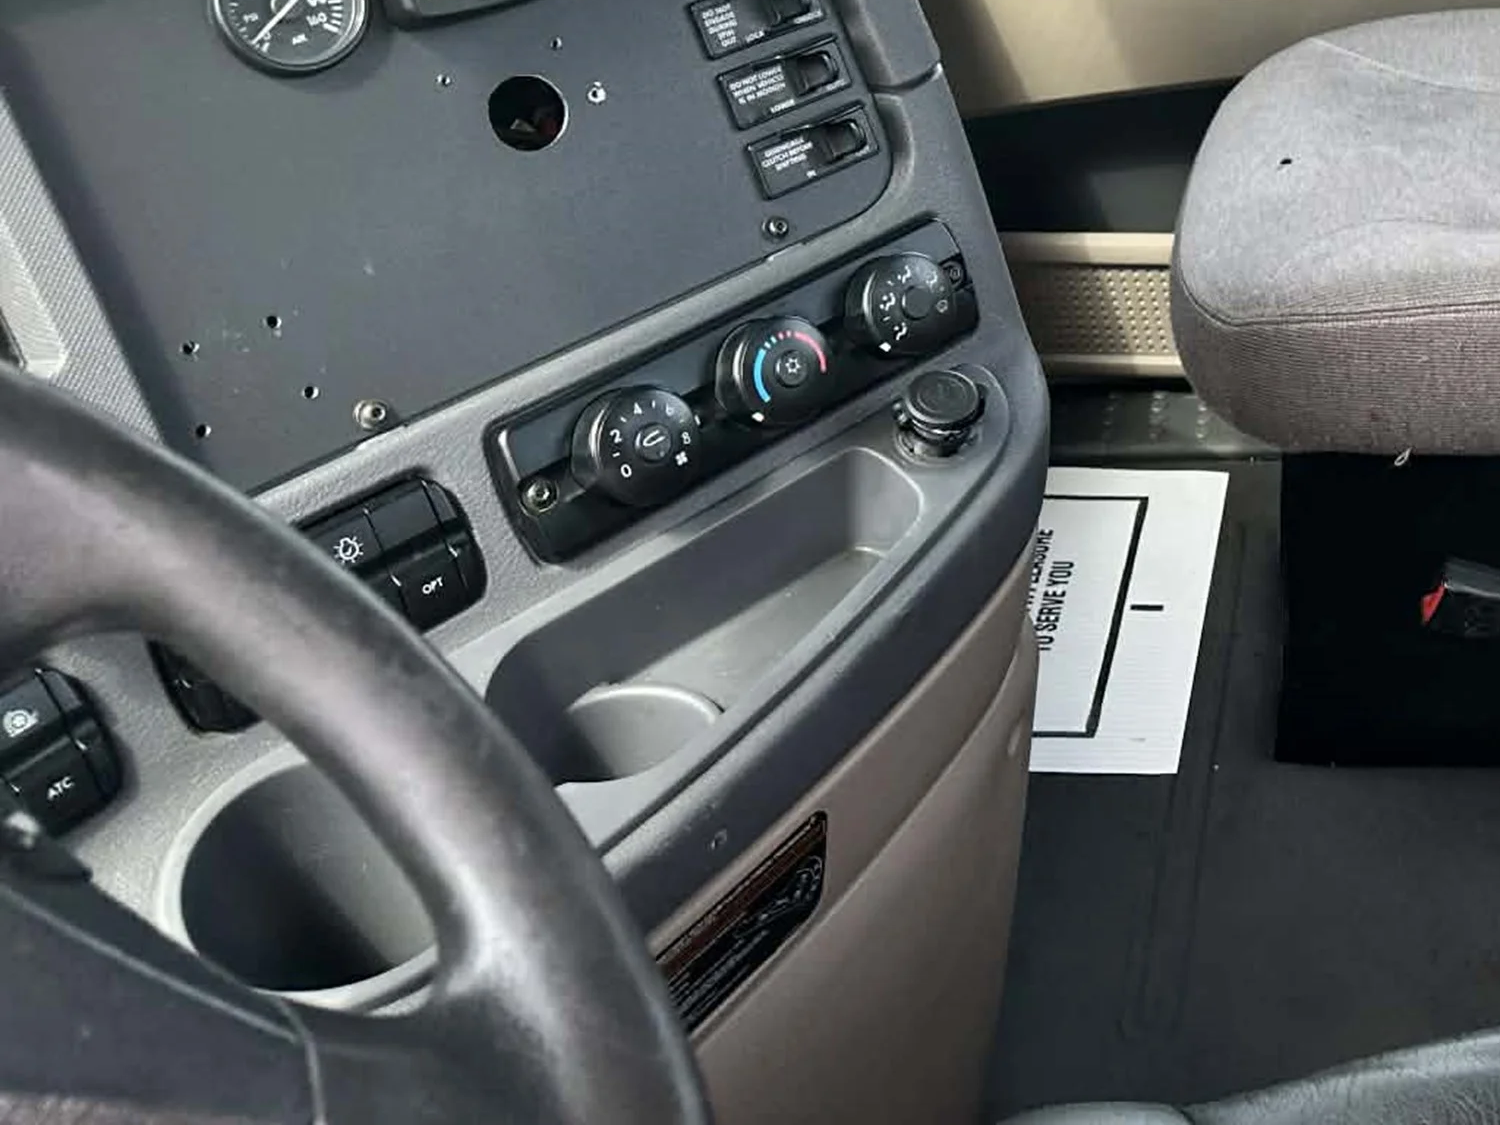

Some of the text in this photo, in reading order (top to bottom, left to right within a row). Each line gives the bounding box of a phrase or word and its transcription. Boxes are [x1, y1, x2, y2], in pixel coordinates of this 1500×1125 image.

[702, 3, 731, 19] DO NOT
[704, 11, 735, 27] ENGAGE
[720, 36, 736, 47] OUT
[745, 30, 765, 43] LOCK
[729, 65, 782, 91] DO NOT LOWER
[732, 74, 784, 97] WHEN VEHICLE
[738, 82, 786, 105] IS IN MOTION
[769, 98, 795, 113] LOWER
[761, 152, 789, 168] CLUTCH
[634, 402, 642, 415] 4
[665, 402, 675, 416] 6
[609, 429, 622, 443] 2
[681, 431, 691, 444] 8
[620, 463, 632, 478] 0
[1046, 561, 1074, 587] YOU
[422, 576, 443, 594] OPT
[1034, 591, 1066, 632] SERVE
[48, 776, 75, 800] ATC
